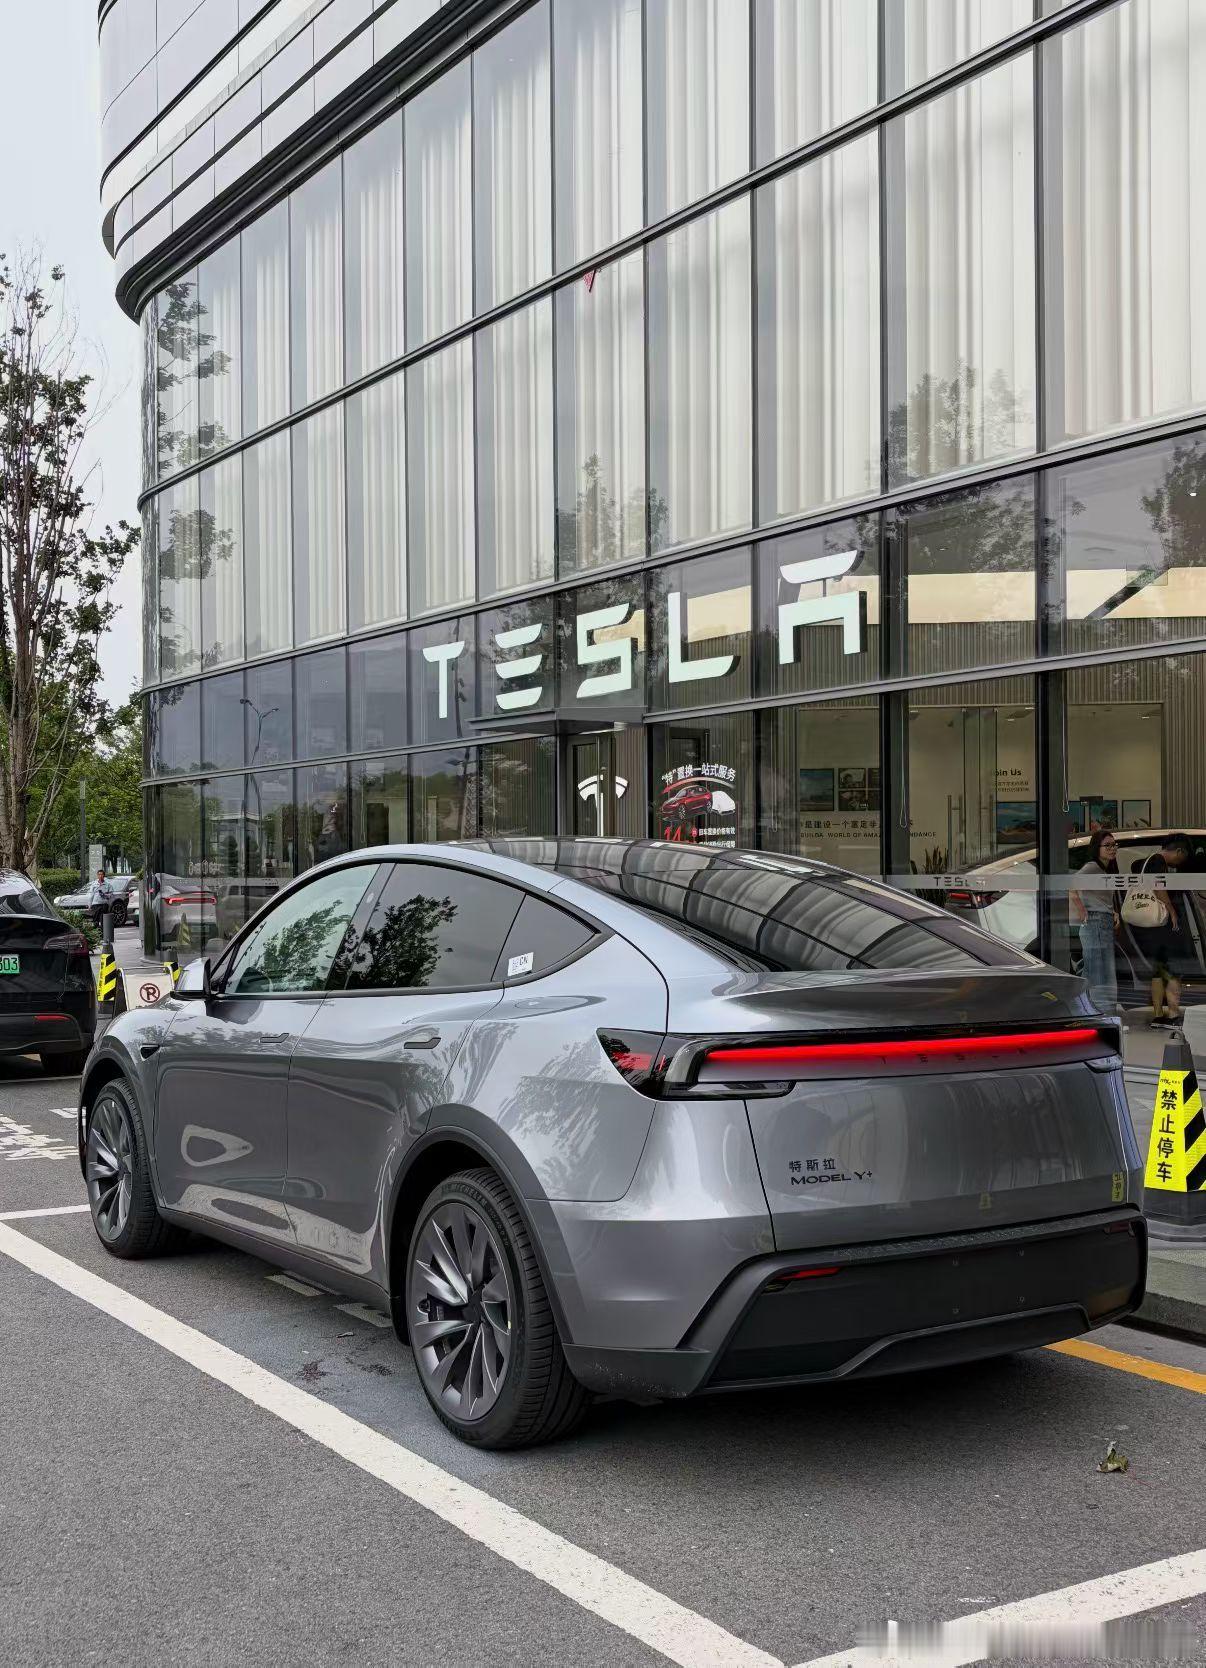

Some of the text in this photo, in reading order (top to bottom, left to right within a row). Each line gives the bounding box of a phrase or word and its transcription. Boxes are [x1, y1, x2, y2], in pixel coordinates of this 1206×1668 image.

[422, 549, 866, 719] TESLA
[994, 768, 1022, 777] oin Us
[1155, 1088, 1178, 1183] 禁止停车
[788, 1157, 837, 1173] 特斯拉
[790, 1170, 873, 1186] MODEL Y+
